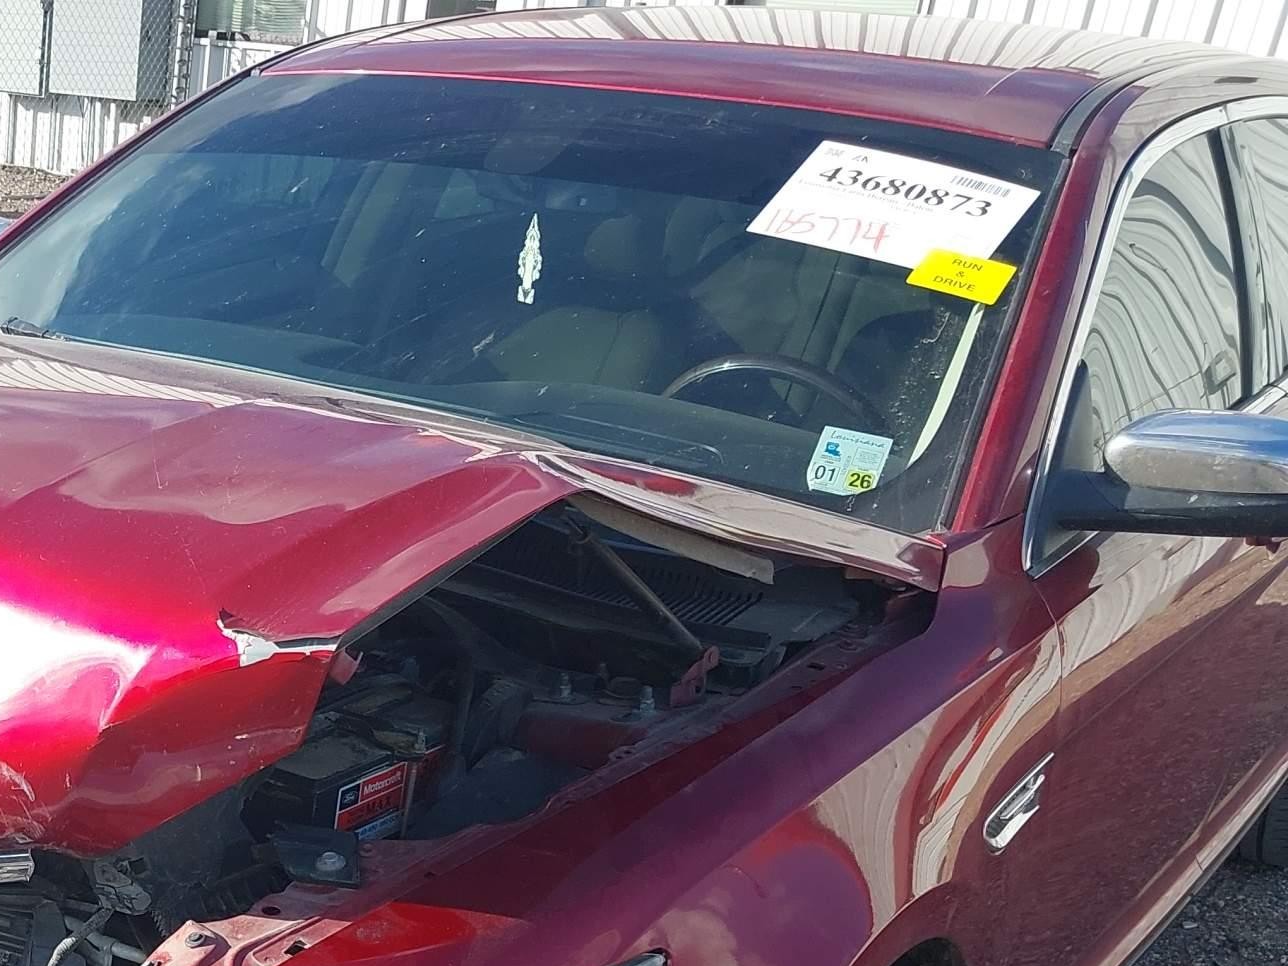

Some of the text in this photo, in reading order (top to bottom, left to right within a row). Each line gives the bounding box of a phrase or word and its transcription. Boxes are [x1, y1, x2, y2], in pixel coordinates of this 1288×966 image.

[818, 165, 993, 217] 43680873
[951, 258, 983, 272] RUN
[955, 270, 966, 278] &
[932, 275, 977, 292] DRIVE
[814, 464, 836, 482] 01
[848, 472, 873, 489] 26
